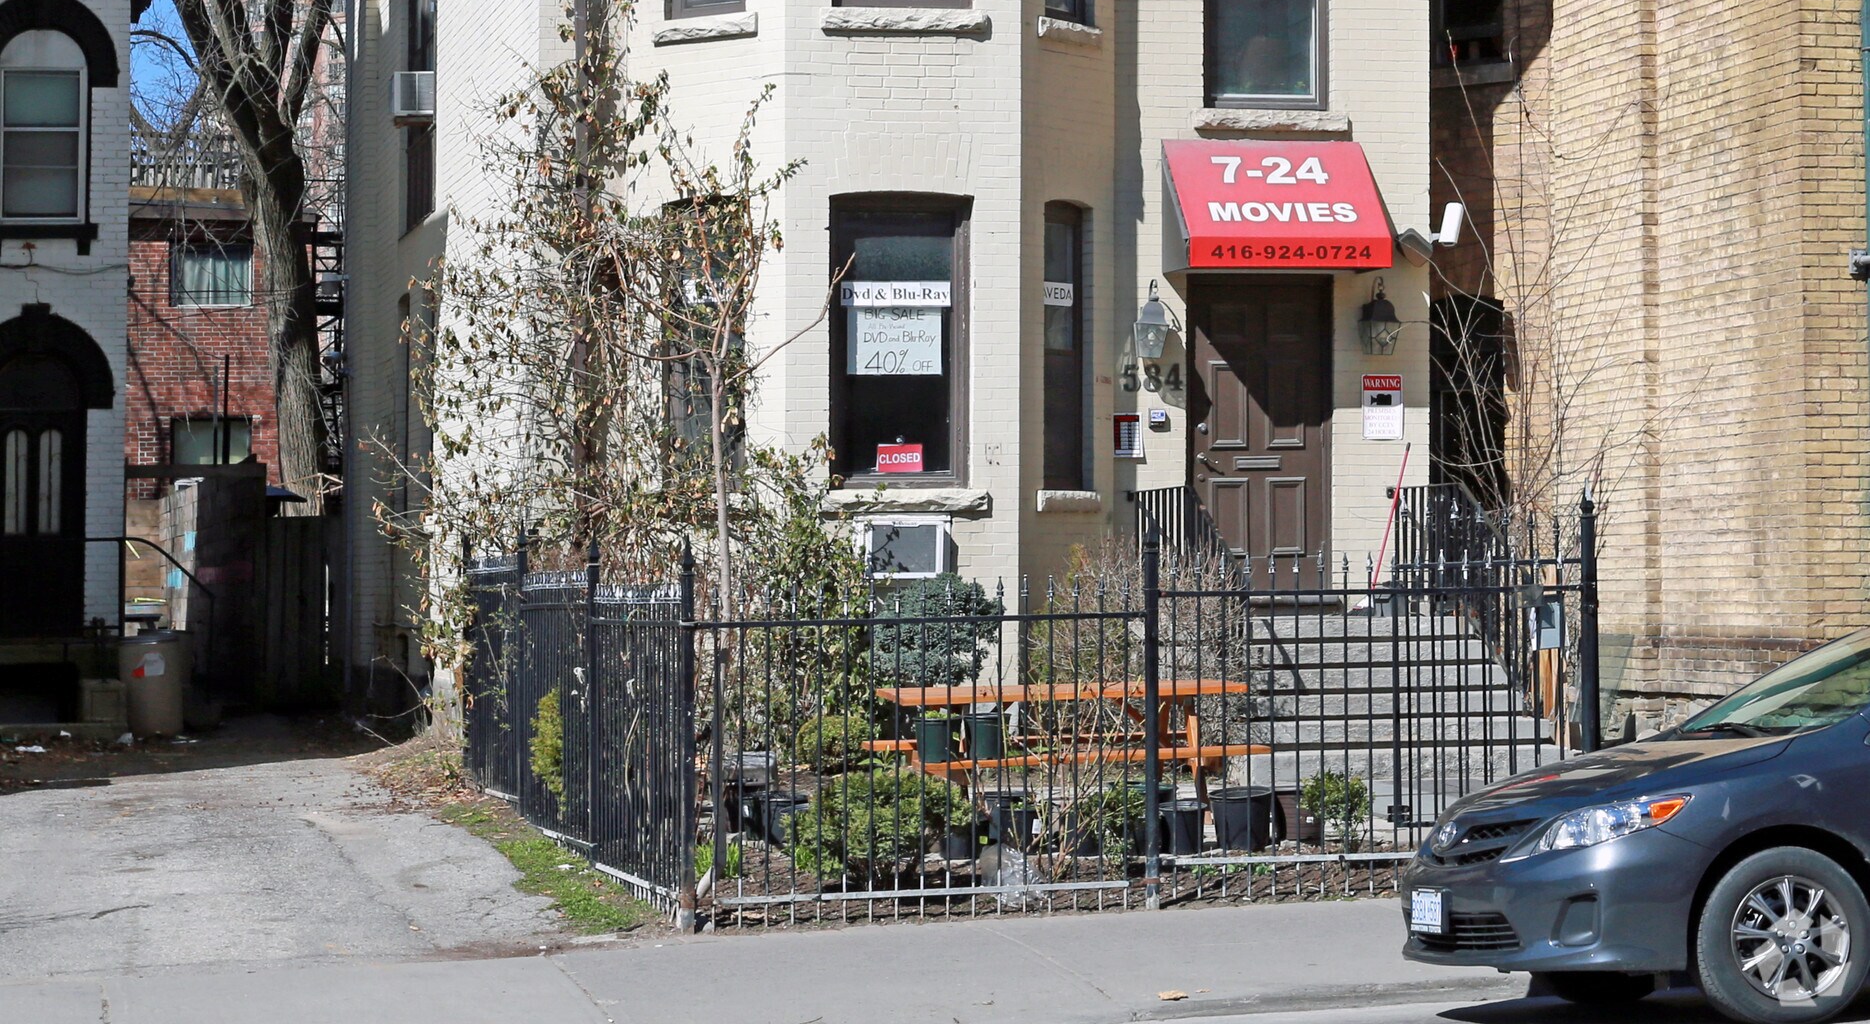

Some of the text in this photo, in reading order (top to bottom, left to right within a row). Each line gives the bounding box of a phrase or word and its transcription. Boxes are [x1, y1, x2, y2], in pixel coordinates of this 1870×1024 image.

[1210, 155, 1330, 185] 7-24
[1206, 201, 1359, 223] MOVIES
[1210, 244, 1372, 260] 416-924-0724
[842, 287, 949, 304] Dvd & Blu-Ray
[864, 307, 926, 321] BIG SALE
[863, 331, 888, 344] DVD
[888, 334, 901, 343] and
[864, 349, 934, 374] 40% OFF
[1122, 363, 1184, 392] 584
[1363, 378, 1400, 388] WARNING
[879, 452, 921, 465] CLOSED
